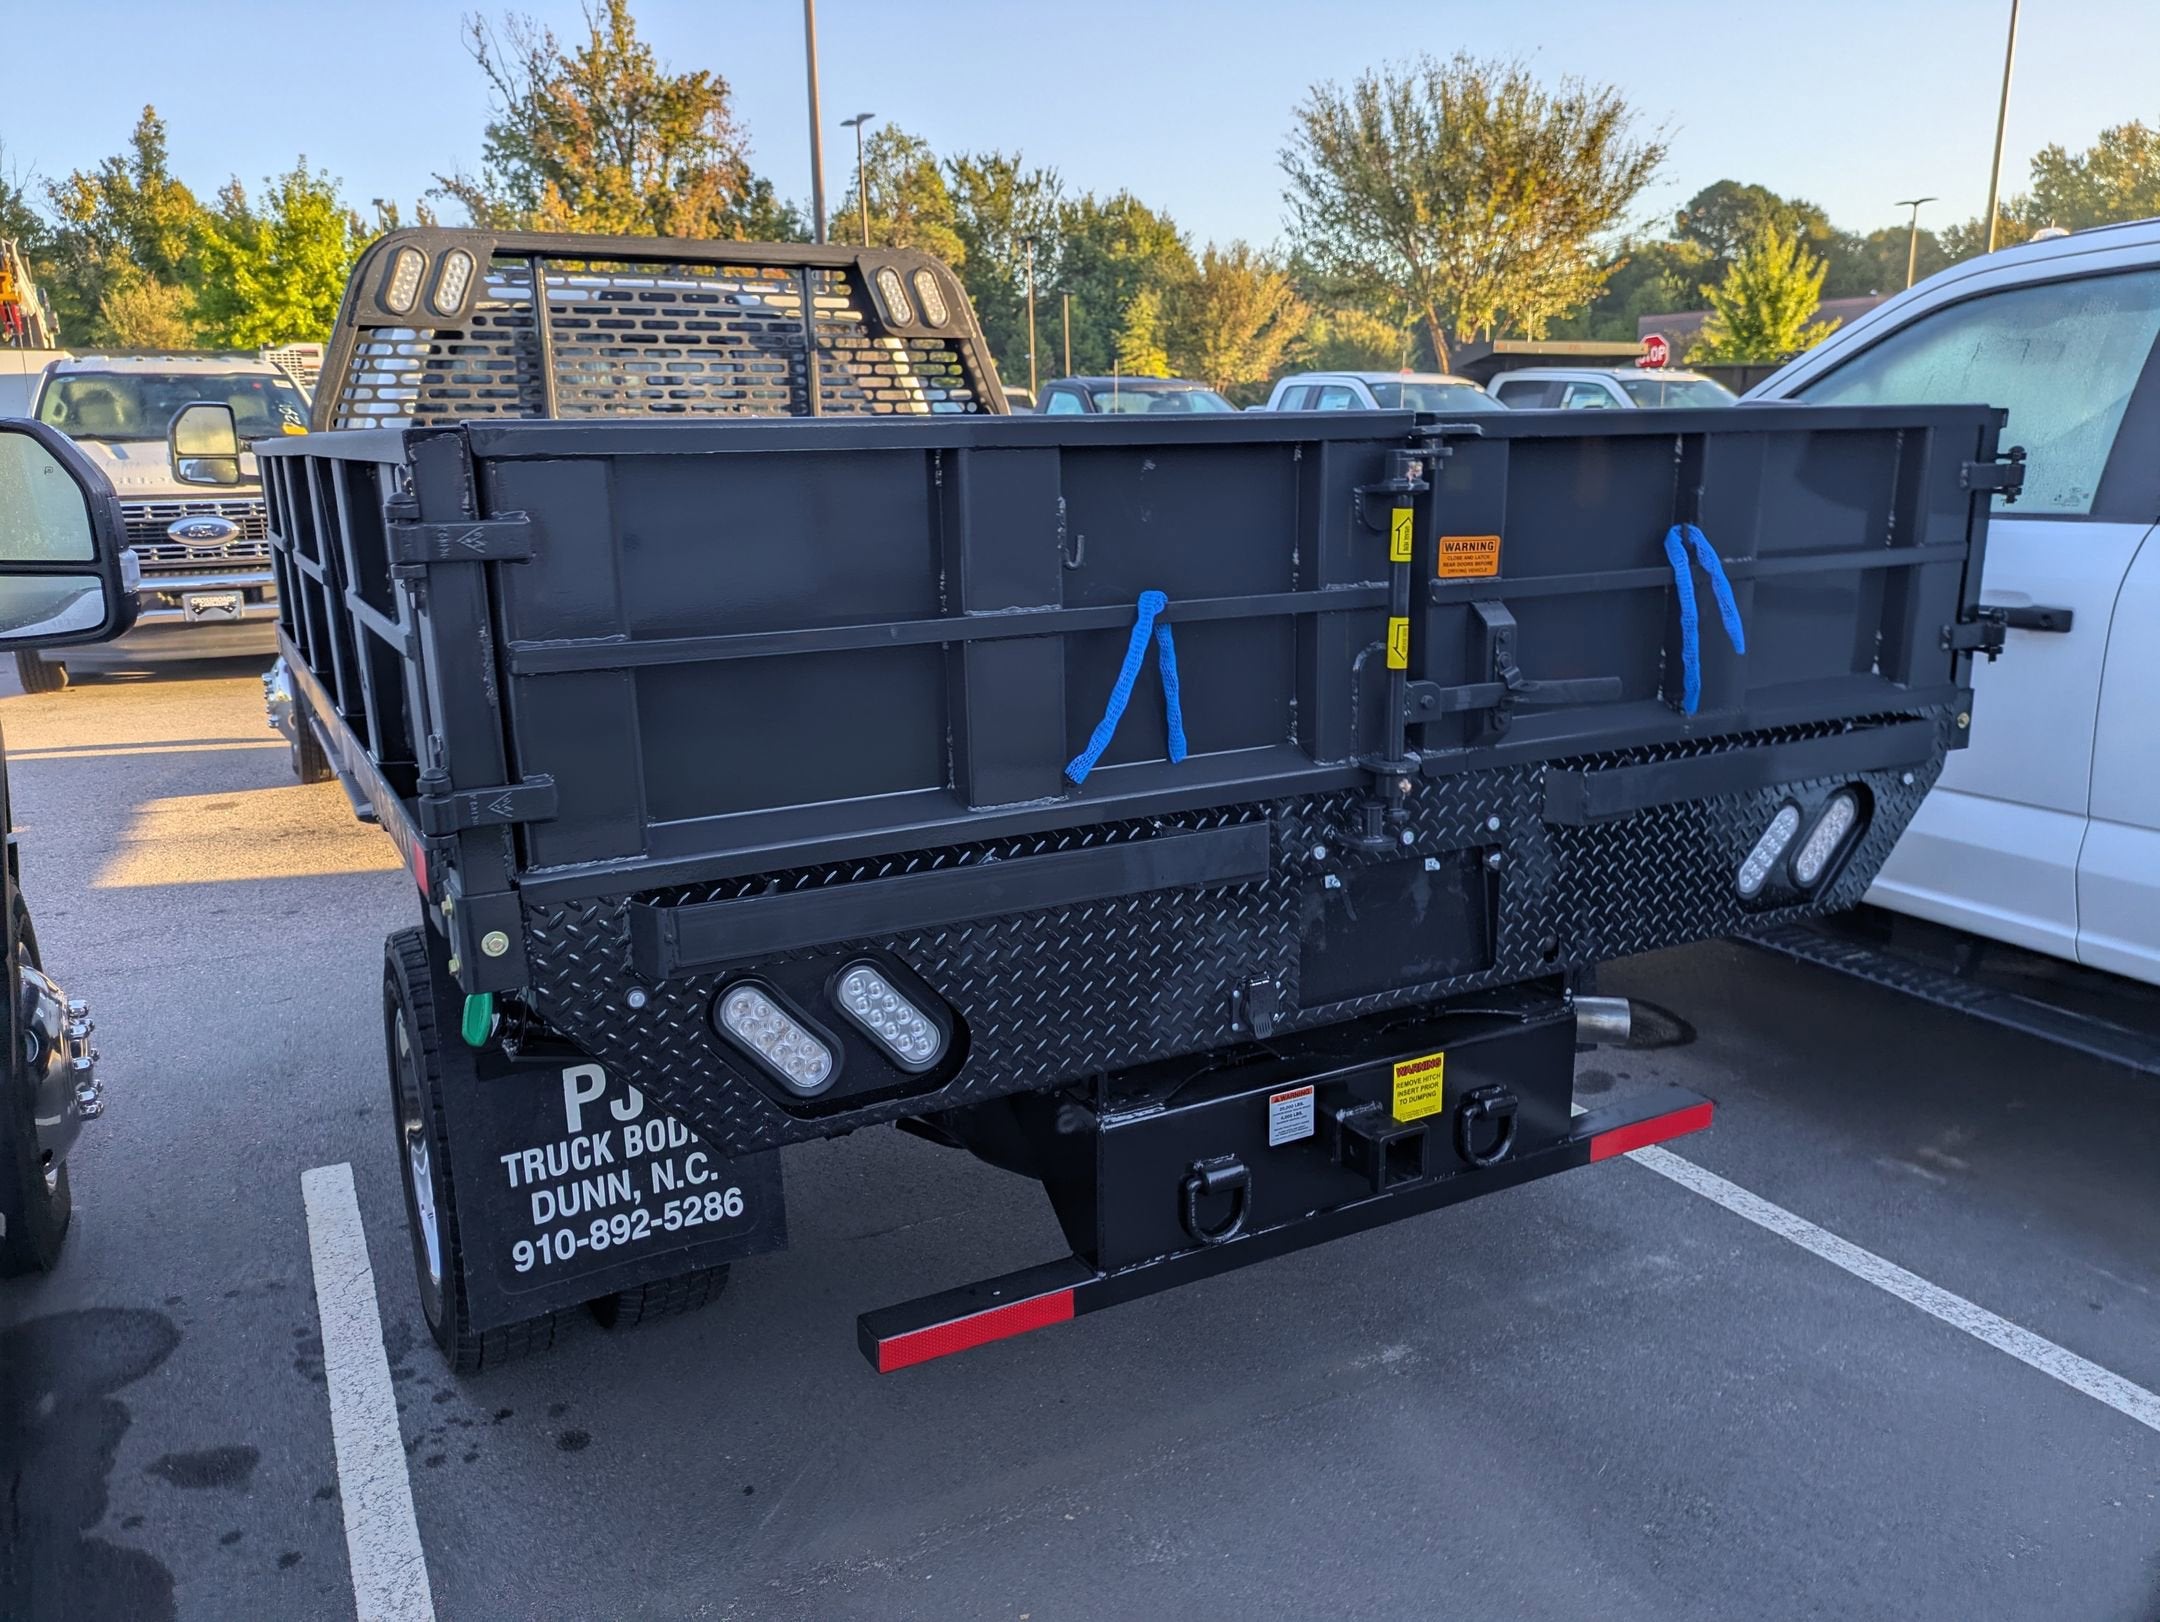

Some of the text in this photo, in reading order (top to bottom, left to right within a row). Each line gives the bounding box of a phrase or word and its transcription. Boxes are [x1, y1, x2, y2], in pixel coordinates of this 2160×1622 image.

[1640, 344, 1666, 364] OP
[1445, 541, 1494, 552] WARNING
[1396, 1057, 1442, 1078] WARNING
[1396, 1072, 1441, 1089] REMOVE HITCH
[1397, 1081, 1439, 1098] INSERT PRIOR
[1399, 1090, 1437, 1106] TO DUMPING
[500, 1115, 699, 1188] TRUCK BOD
[531, 1151, 719, 1226] DUNN, N.C.
[512, 1187, 744, 1273] 910-892-5286
